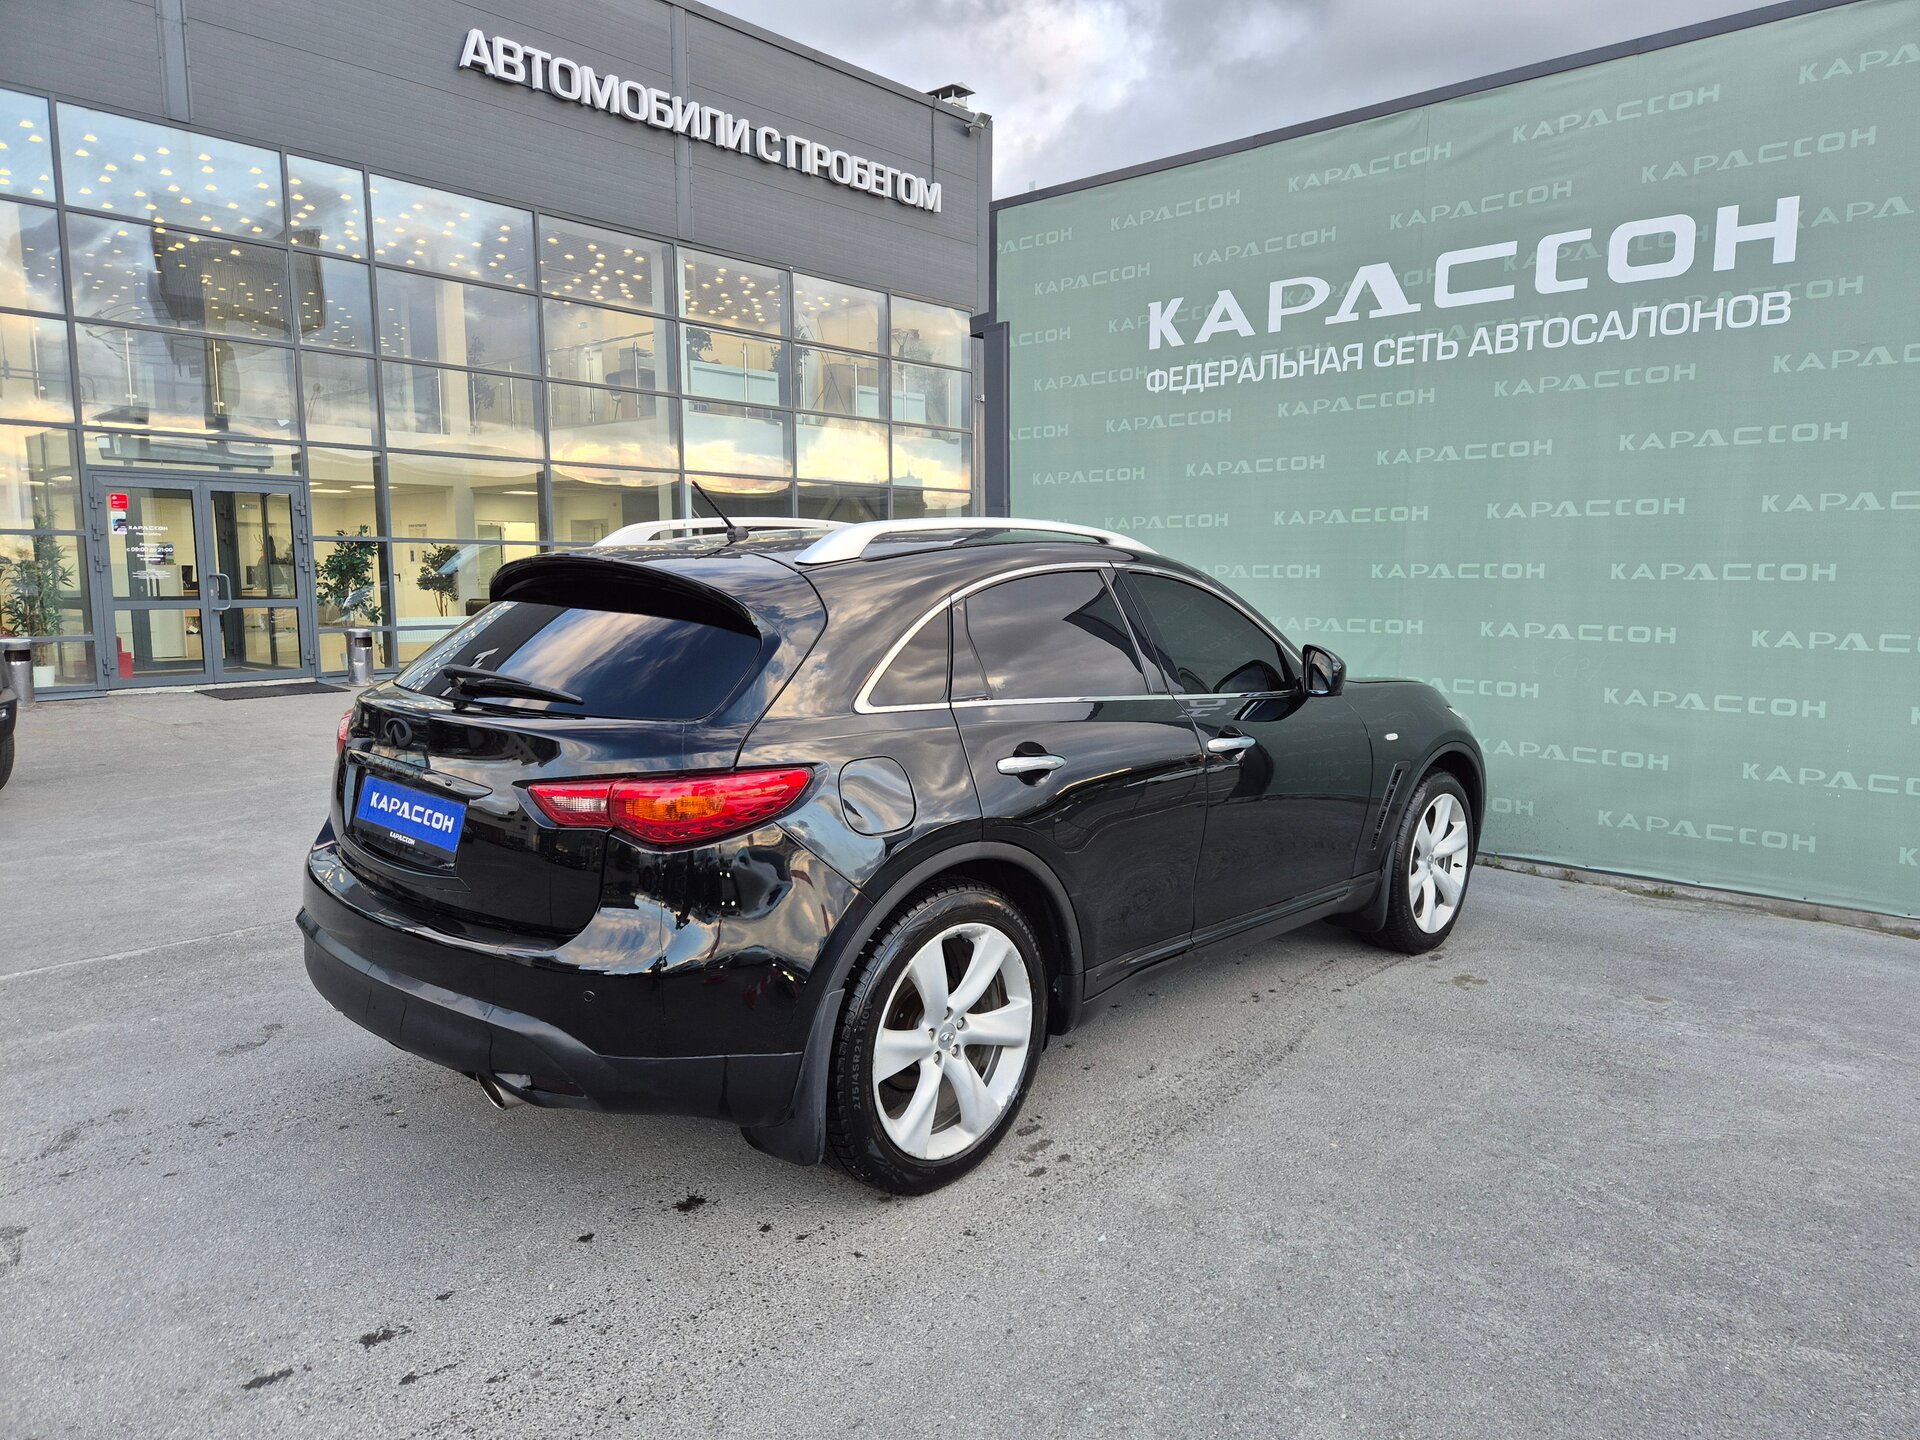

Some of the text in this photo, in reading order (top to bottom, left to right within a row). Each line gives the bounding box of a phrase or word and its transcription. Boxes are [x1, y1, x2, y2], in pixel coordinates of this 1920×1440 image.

[459, 28, 942, 214] АВТОМОБИЛИ С ПРОБЕГОМ
[1512, 84, 1720, 143] КАРАССОН
[1289, 142, 1452, 193] КАРАССОН
[1642, 125, 1877, 183] КАРАССОН
[1110, 189, 1241, 231] КАРАССОН
[1390, 178, 1573, 230] КАРАССОН
[1193, 226, 1337, 267] КАРАССОН
[1035, 262, 1150, 296] КАРАССОН
[1148, 195, 1800, 350] КАРАССОН
[1146, 290, 1792, 395] ФЕДЕРАЛЬНАЯ СЕТЬ АВТОСАЛОНОВ
[1033, 365, 1148, 393] КАРАССОН
[1494, 363, 1697, 398] КАРАССОН
[1278, 387, 1436, 418] КАРАССОН
[1106, 408, 1232, 433] КАРАССОН
[1377, 439, 1553, 465] КАРАССОН
[1619, 421, 1849, 452] КАРАССОН
[1033, 467, 1145, 486] КАРАССОН
[1186, 454, 1326, 478] КАРАССОН
[1105, 513, 1229, 530] КАРАССОН
[1274, 505, 1429, 526] КАРАССОН
[1487, 497, 1686, 519] КАРАССОН
[1371, 563, 1545, 580] КАРАССОН
[1611, 562, 1837, 582] КАРАССОН
[1481, 621, 1677, 645] КАРАССОН
[1752, 630, 1920, 654] КАРАС
[1604, 688, 1827, 719] КАРАССОН
[370, 791, 456, 834] КАРАССОН
[389, 831, 416, 846] КАРАССОН
[1598, 810, 1817, 853] КАРАССОН
